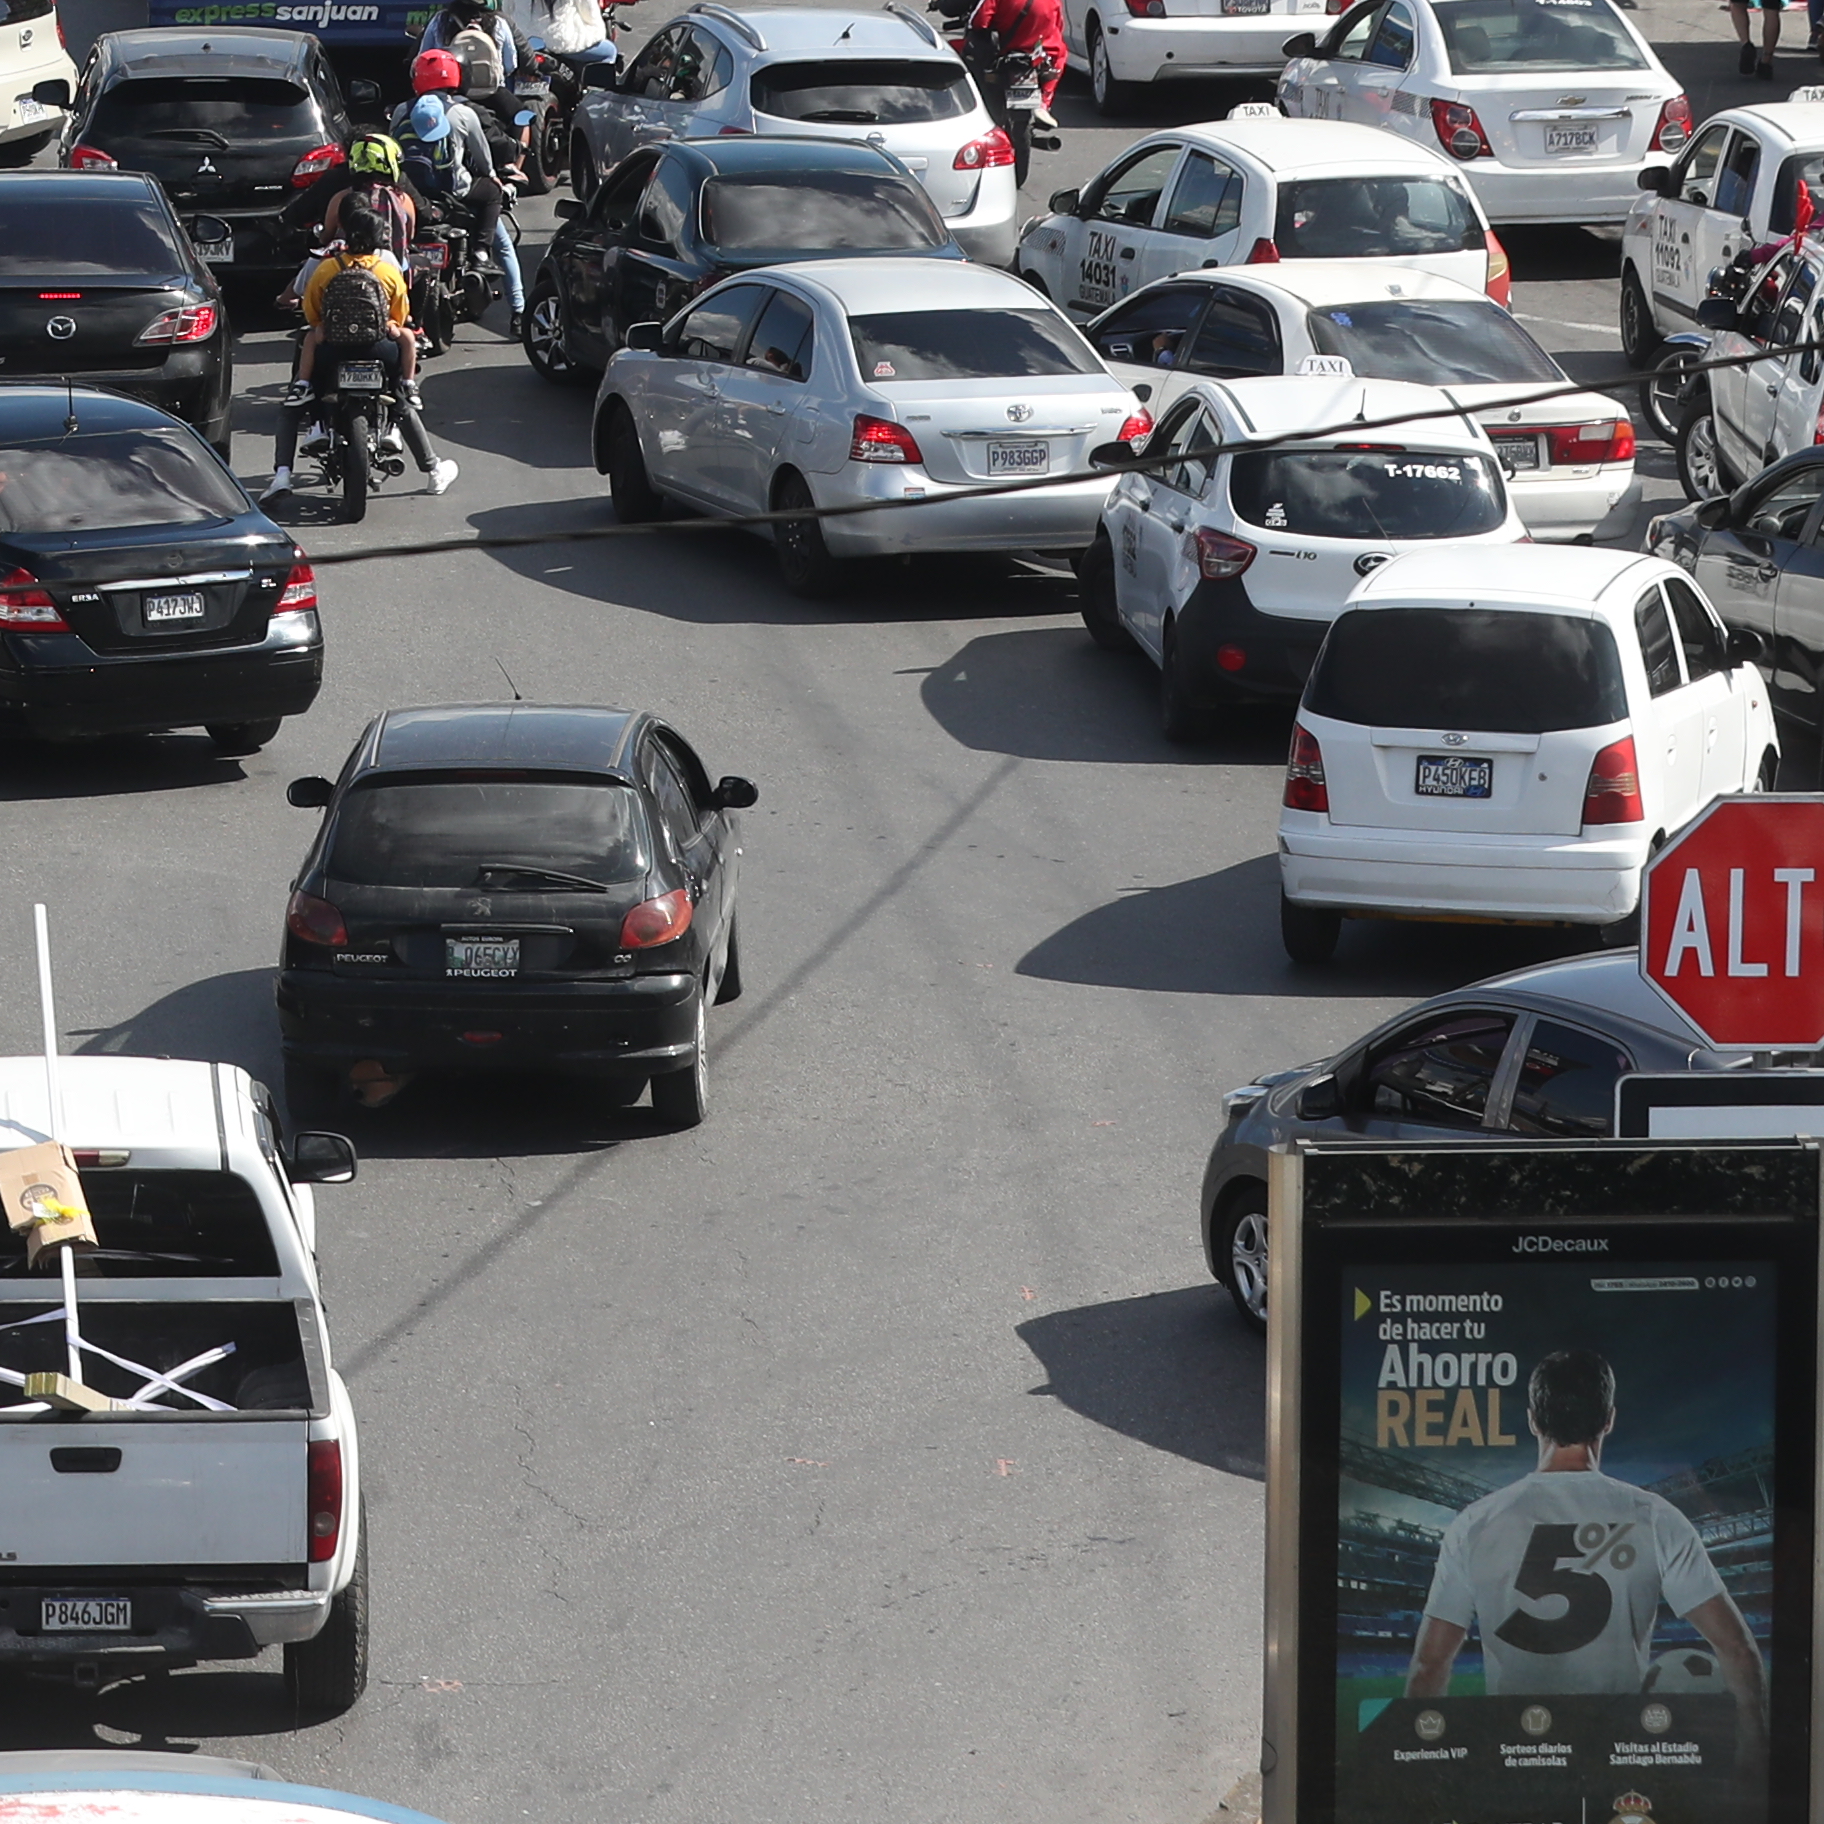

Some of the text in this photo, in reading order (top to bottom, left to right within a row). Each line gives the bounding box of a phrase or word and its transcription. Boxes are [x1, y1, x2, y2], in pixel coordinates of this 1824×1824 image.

[1243, 105, 1271, 118] TAXI
[1658, 214, 1677, 243] TAXI
[1089, 231, 1117, 262] TAXI
[1655, 242, 1681, 271] 11092
[1079, 258, 1117, 289] 14031
[1306, 359, 1344, 373] TAXI
[991, 447, 1047, 467] P983GGP
[1383, 463, 1461, 481] T-17662
[146, 593, 204, 618] P417JWJ
[1417, 785, 1464, 795] HYUNDAI
[335, 952, 389, 964] PEUGEOT
[454, 968, 518, 978] PEUGEOT
[1512, 1235, 1609, 1253] JCDecaux
[1379, 1292, 1503, 1313] Es momento
[1378, 1319, 1486, 1341] de hacer tu
[1378, 1344, 1518, 1390] Ahorro
[1377, 1388, 1518, 1449] REAL
[44, 1602, 130, 1627] P846JGM
[1394, 1749, 1468, 1763] Experiencia VIP
[1500, 1743, 1573, 1755] Sorteos diarios
[1613, 1741, 1699, 1753] Visitas al Estadio
[1504, 1756, 1568, 1768] de camisolas
[1609, 1752, 1702, 1766] Santiago Bernabéu
